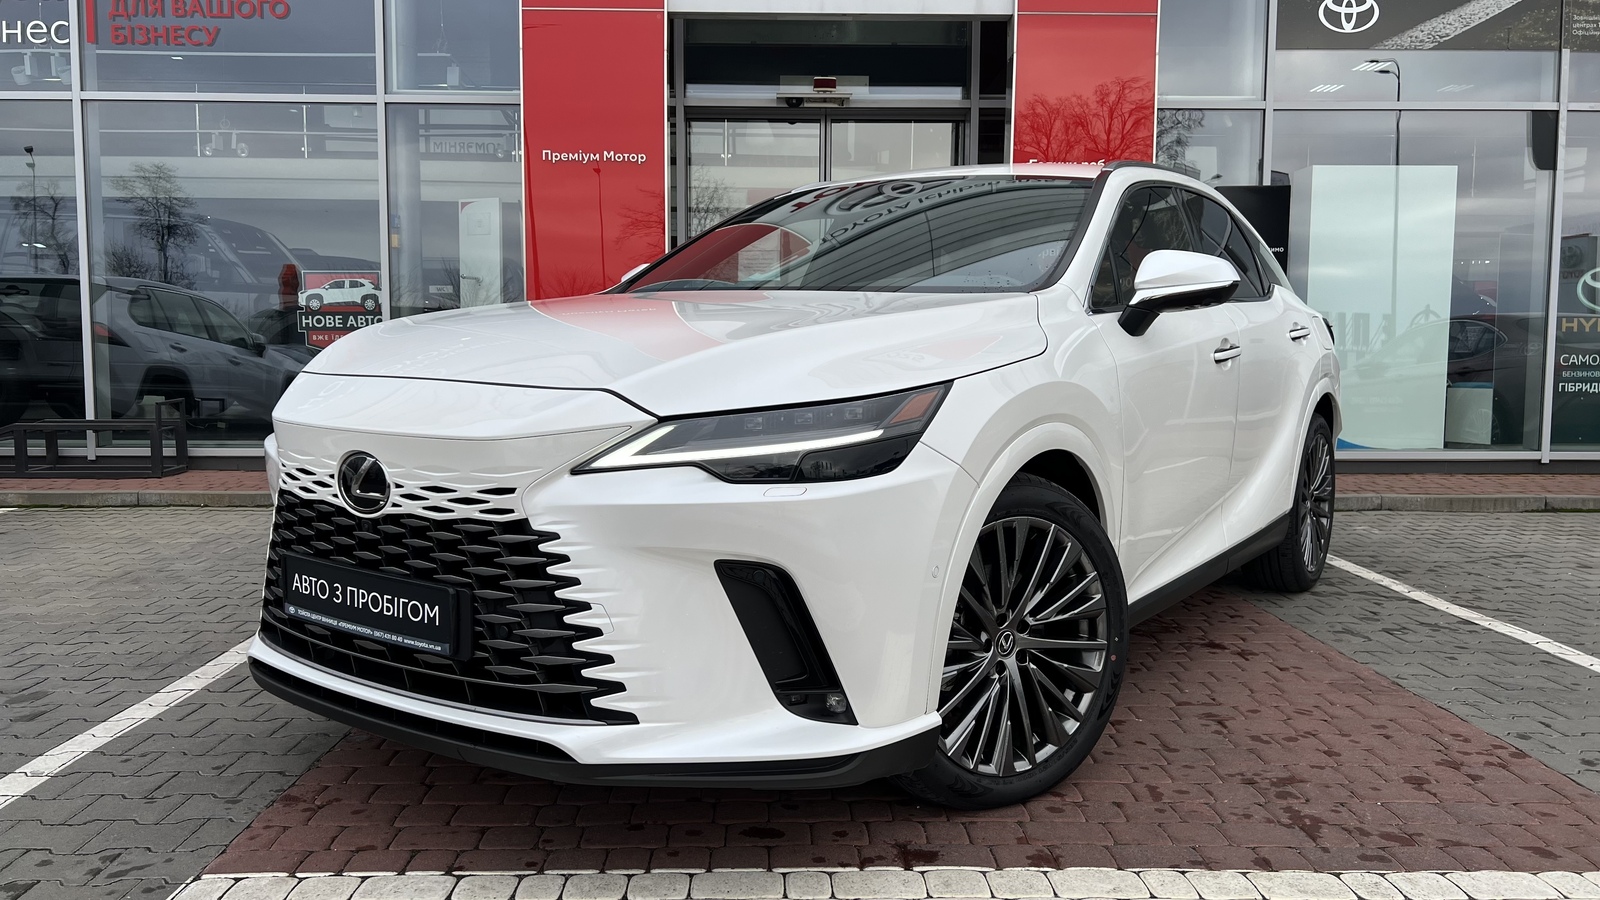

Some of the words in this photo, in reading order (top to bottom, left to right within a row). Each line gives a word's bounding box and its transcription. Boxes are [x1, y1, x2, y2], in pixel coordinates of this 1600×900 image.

[108, 0, 165, 20] ДЛЯ
[171, 0, 290, 19] ВАШОГО
[1, 19, 69, 44] нес
[110, 24, 219, 46] БІЗНЕСУ
[542, 149, 599, 164] Преміум
[603, 150, 647, 164] Мотор
[302, 315, 343, 328] НОВЕ
[1560, 354, 1600, 366] САМО
[292, 572, 330, 600] АВТО
[333, 583, 343, 604] З
[346, 586, 440, 626] ПРОБІГОМ
